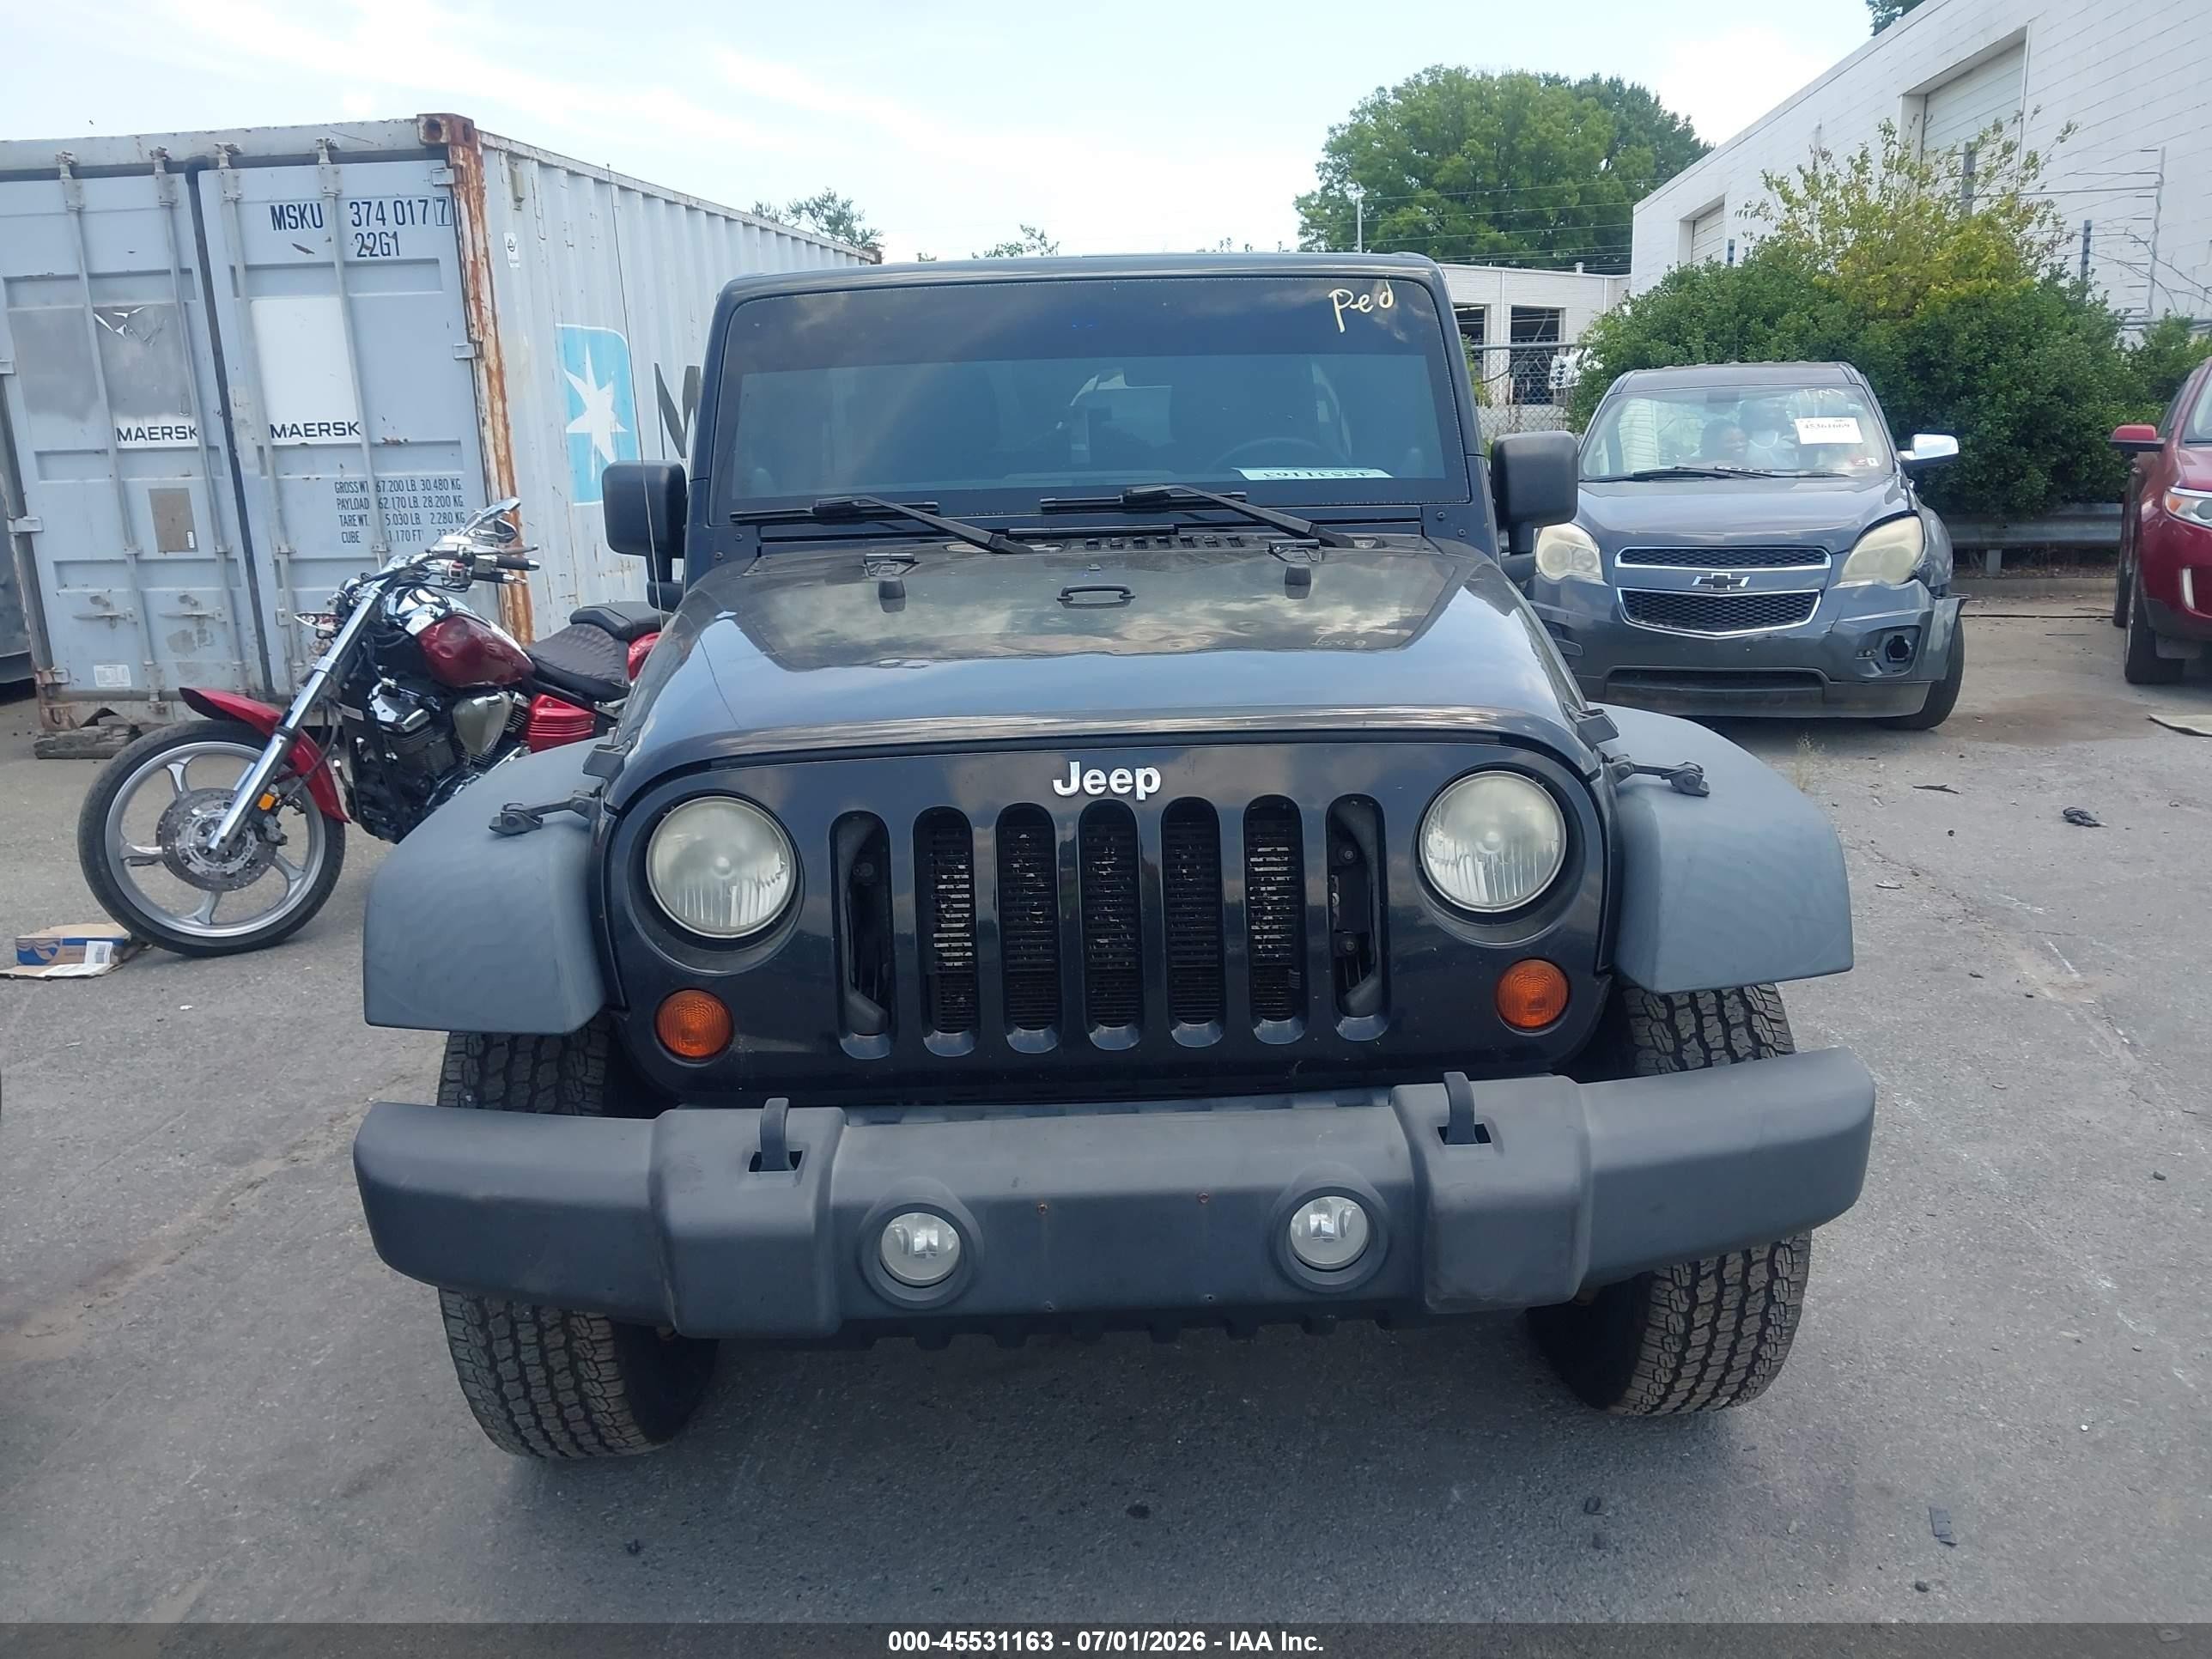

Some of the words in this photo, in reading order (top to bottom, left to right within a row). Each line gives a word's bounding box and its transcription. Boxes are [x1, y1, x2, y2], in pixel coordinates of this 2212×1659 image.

[270, 202, 325, 231] MSKU
[349, 200, 387, 228] 374
[392, 198, 429, 226] 017
[354, 230, 401, 258] 22G1
[116, 425, 198, 441] MAERSK
[269, 421, 362, 439] MAERSK
[334, 481, 359, 494] GROSS
[336, 497, 370, 510] PAYLOAD
[338, 514, 358, 527] TARE
[341, 530, 361, 544] CUBE
[1052, 761, 1162, 801] Jeep
